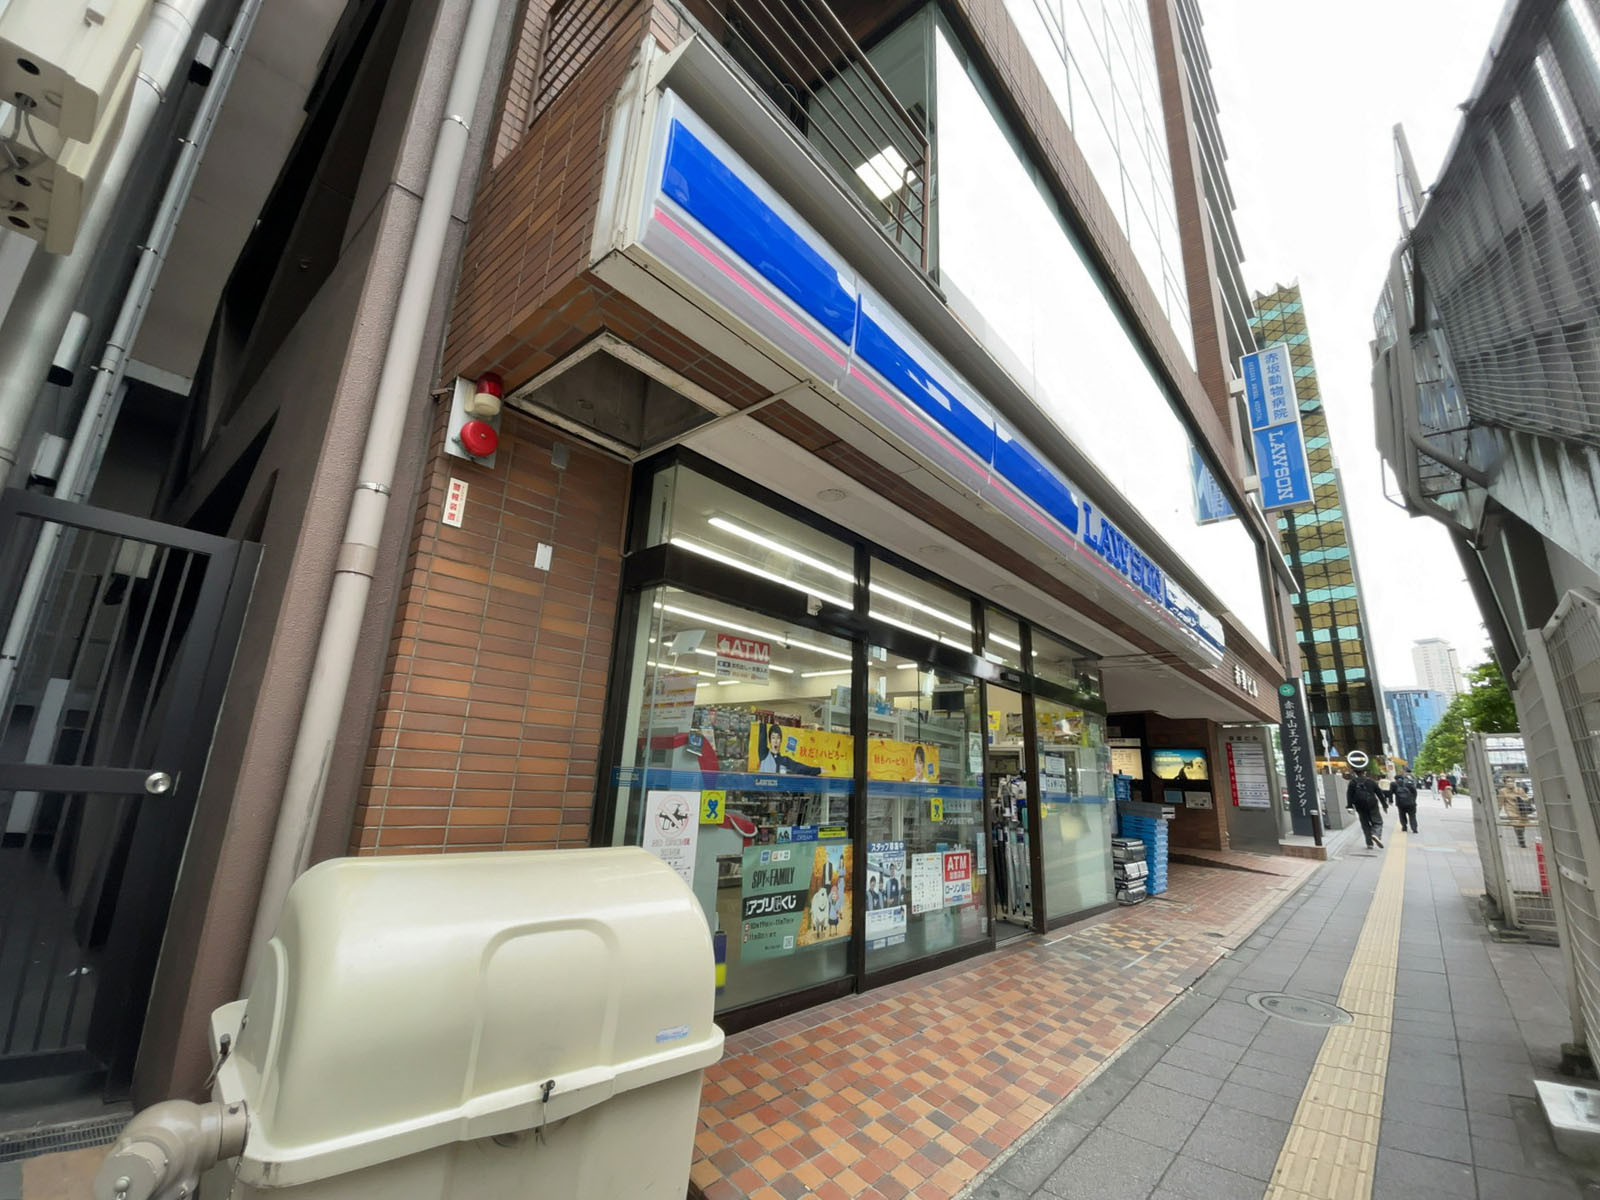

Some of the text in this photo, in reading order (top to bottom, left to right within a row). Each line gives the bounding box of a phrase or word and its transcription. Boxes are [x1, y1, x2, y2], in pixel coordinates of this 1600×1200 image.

[1265, 352, 1288, 421] 赤坂動物病院
[1269, 430, 1294, 500] LAWSON
[1082, 501, 1163, 604] LAWSON
[731, 639, 770, 662] ATM
[1284, 700, 1308, 816] 赤坂山王メディカルセンター
[947, 855, 967, 872] ATM
